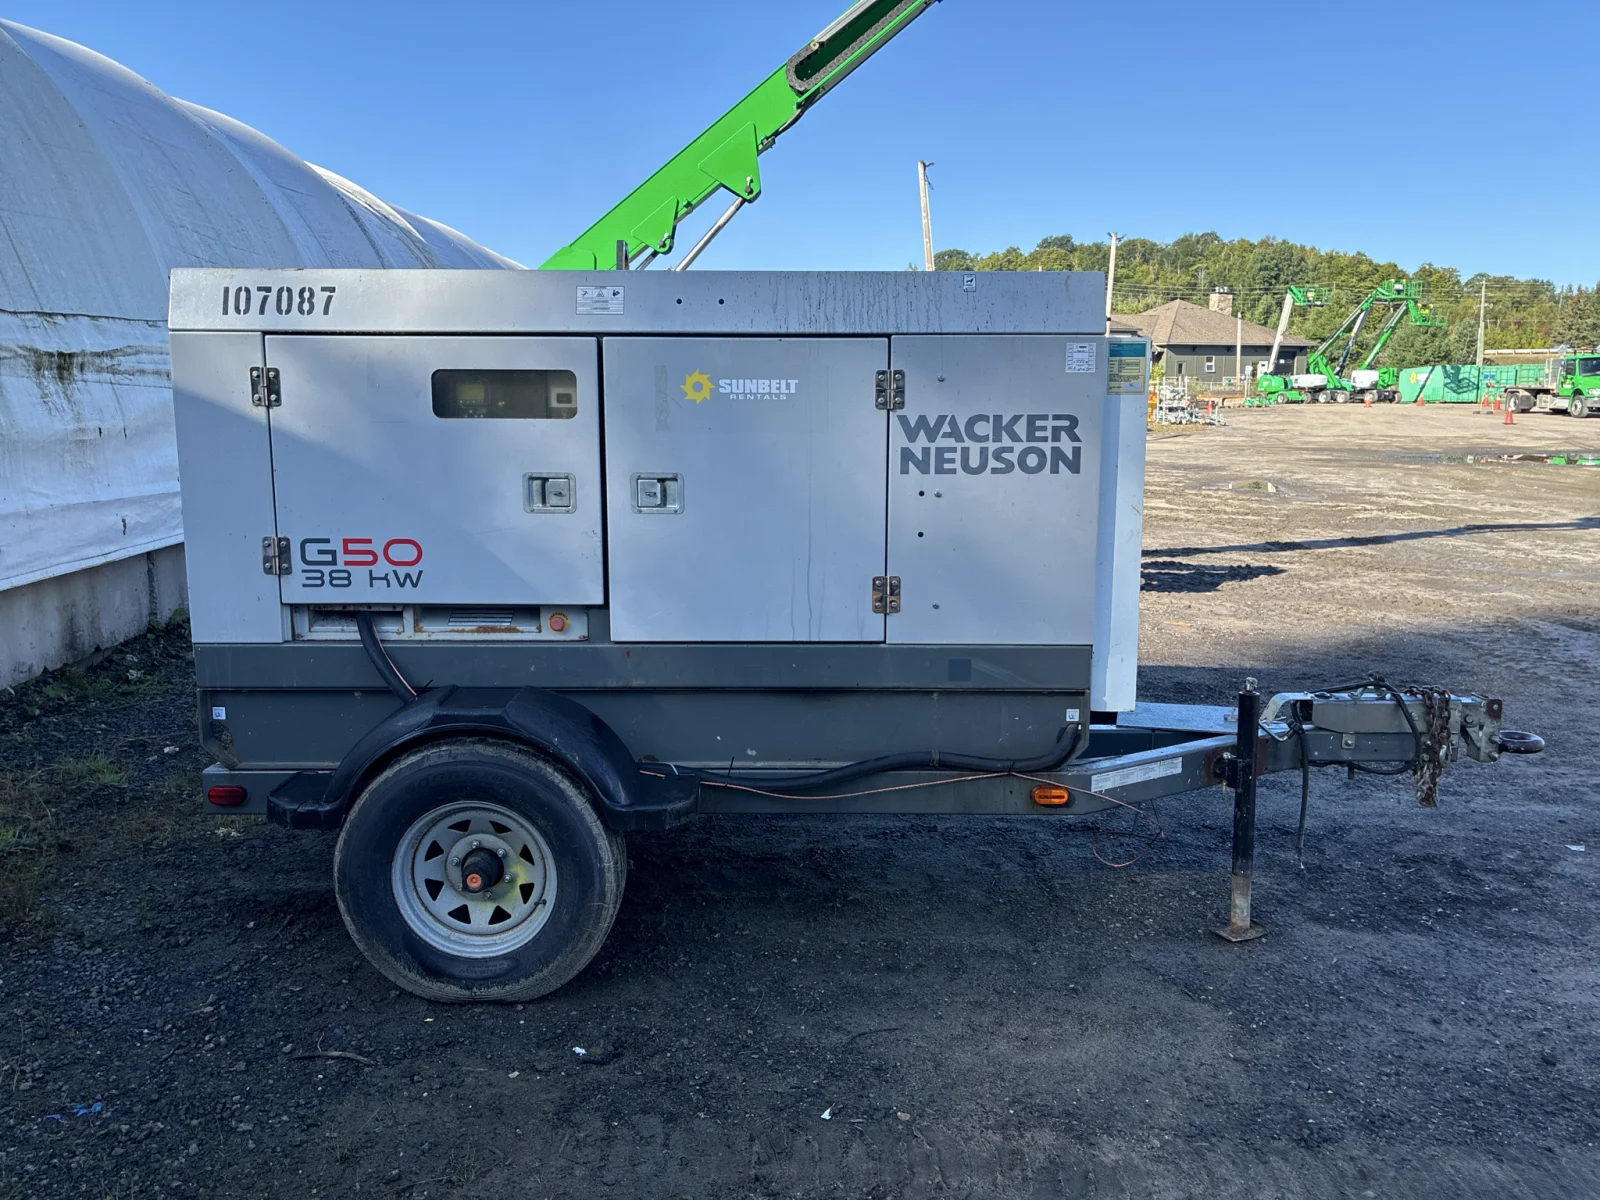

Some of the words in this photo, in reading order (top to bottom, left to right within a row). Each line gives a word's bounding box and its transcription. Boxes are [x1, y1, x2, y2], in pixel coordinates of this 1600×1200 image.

[222, 286, 336, 316] 107087
[718, 379, 798, 393] SUNBELT
[896, 413, 1082, 443] WACKER
[899, 446, 1082, 475] NEUSON
[300, 538, 423, 566] G50
[301, 569, 352, 588] 38
